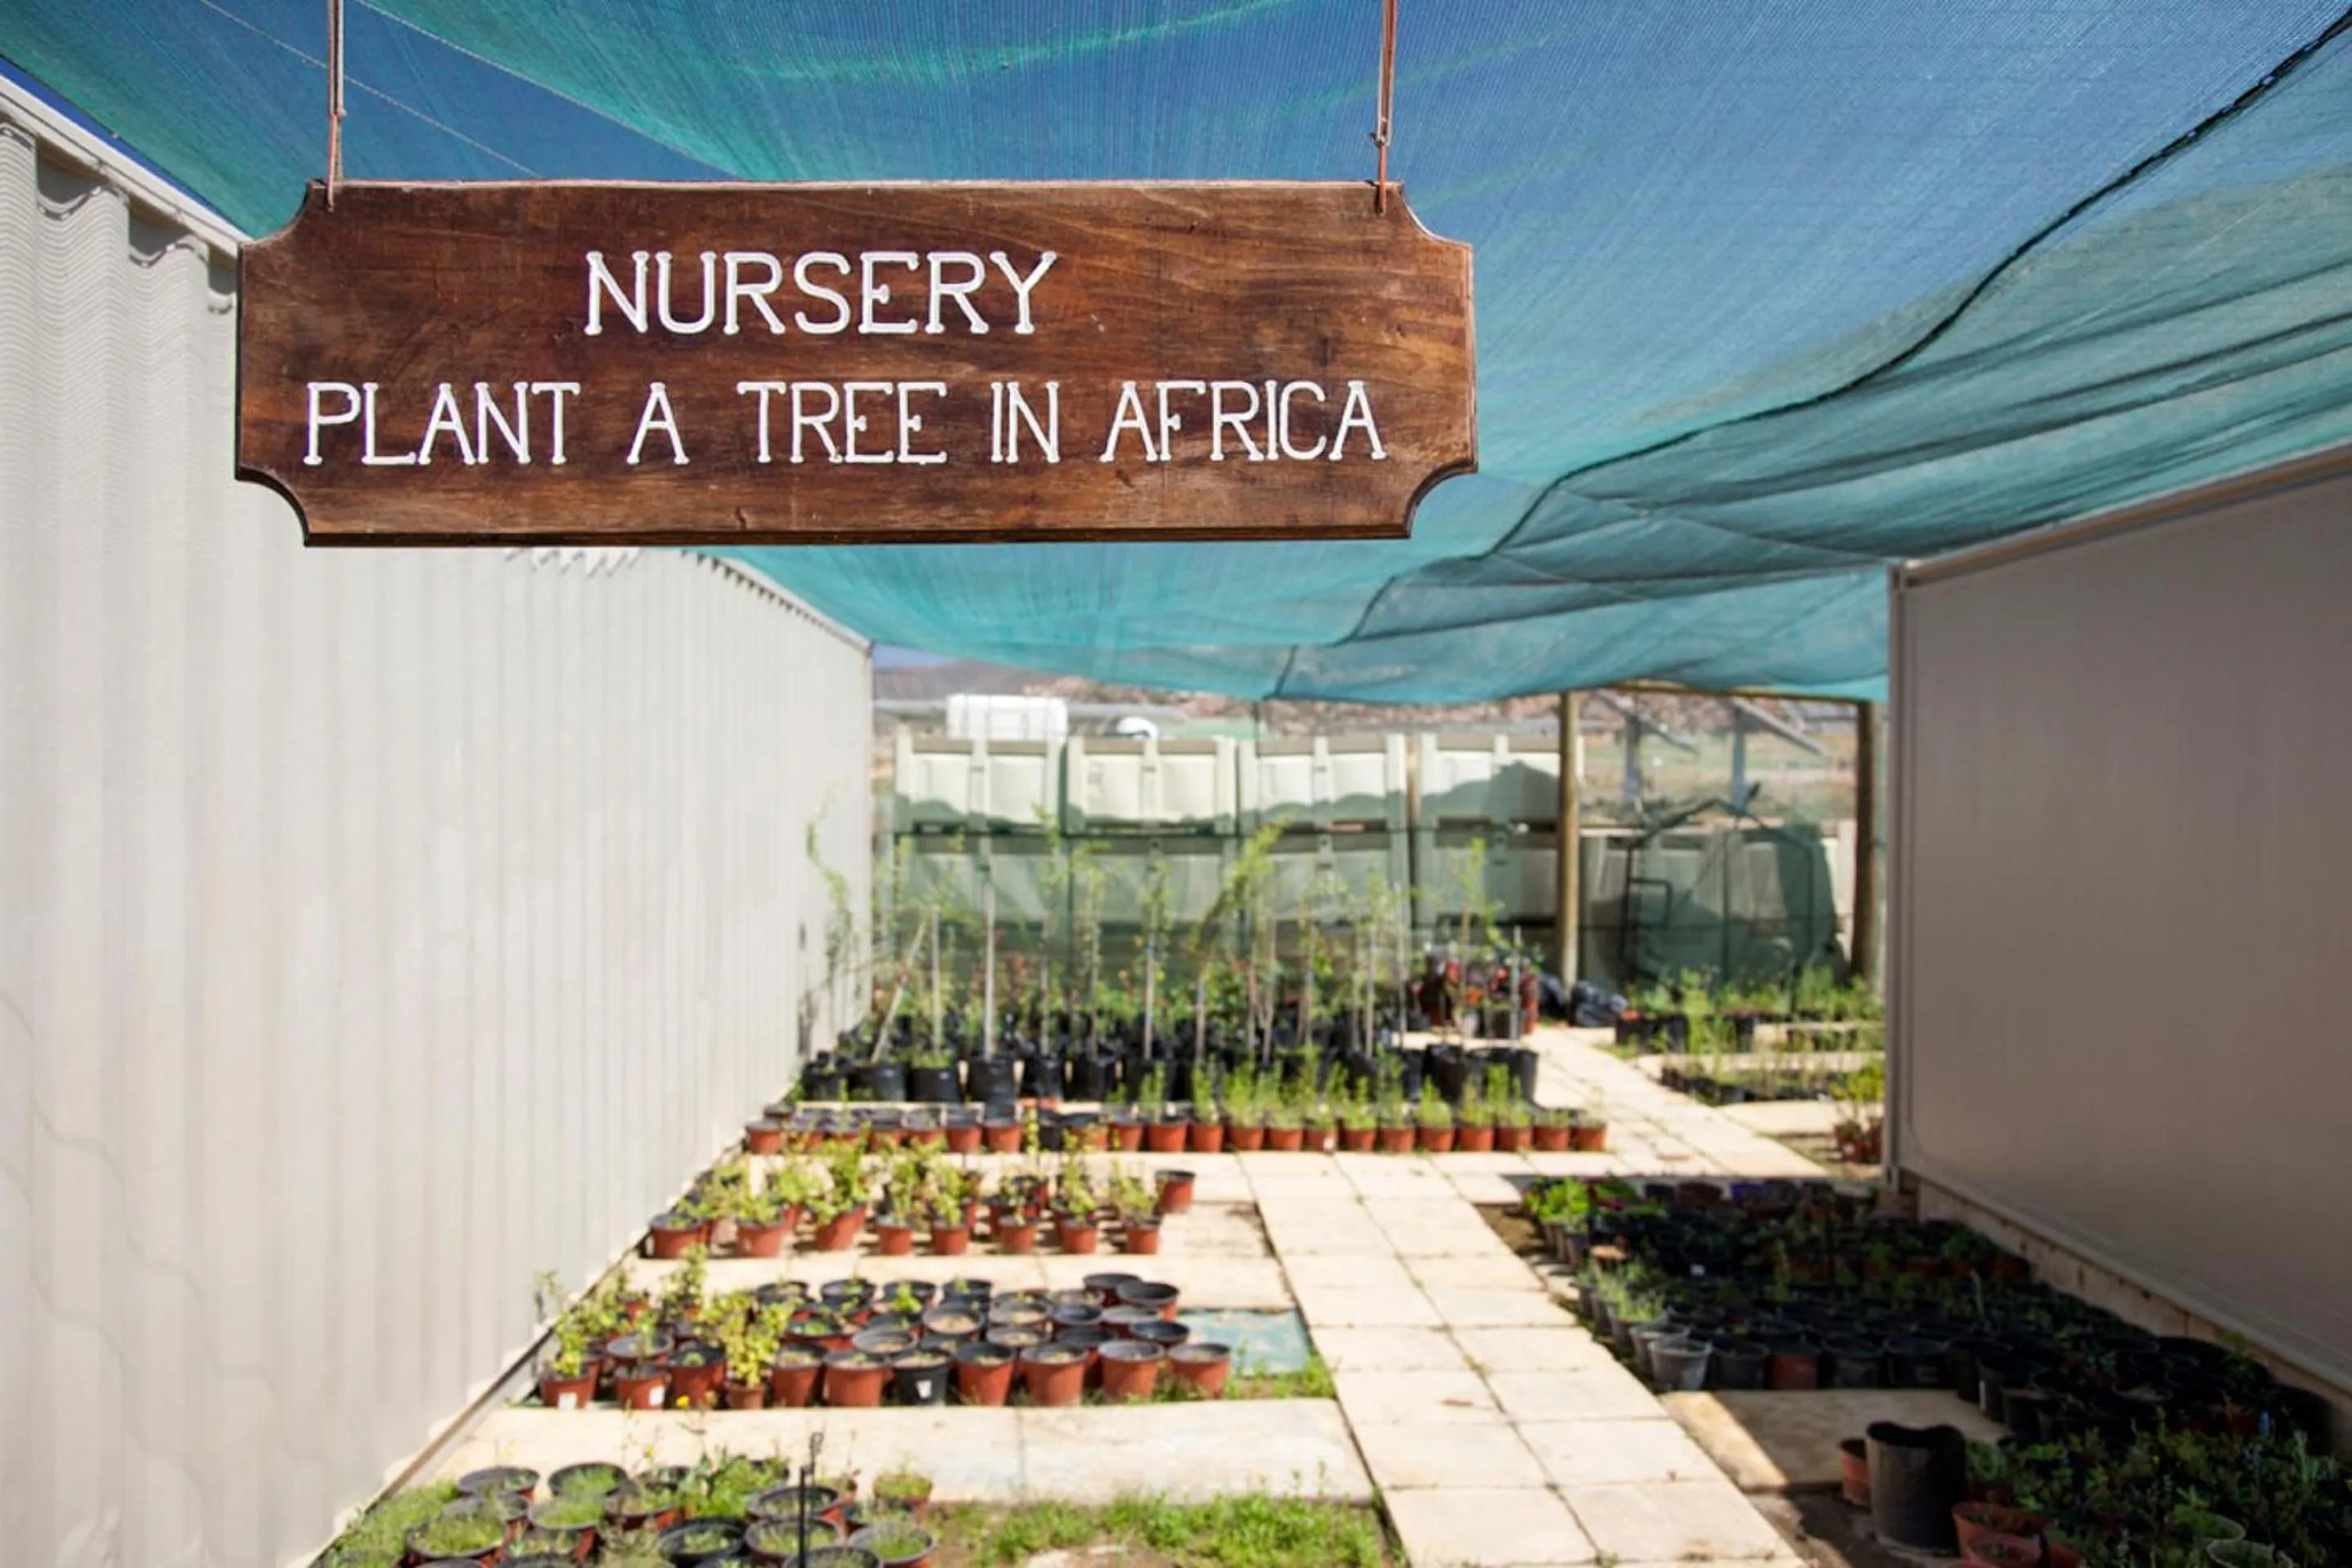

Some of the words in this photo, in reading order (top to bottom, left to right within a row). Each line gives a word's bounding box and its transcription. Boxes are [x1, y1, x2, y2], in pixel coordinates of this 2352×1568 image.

[583, 250, 1058, 336] NURSERY
[303, 381, 581, 466] PLANT
[626, 381, 689, 466] A
[736, 380, 947, 466] TREE
[990, 380, 1060, 464] IN
[1099, 379, 1388, 463] AFRICA
